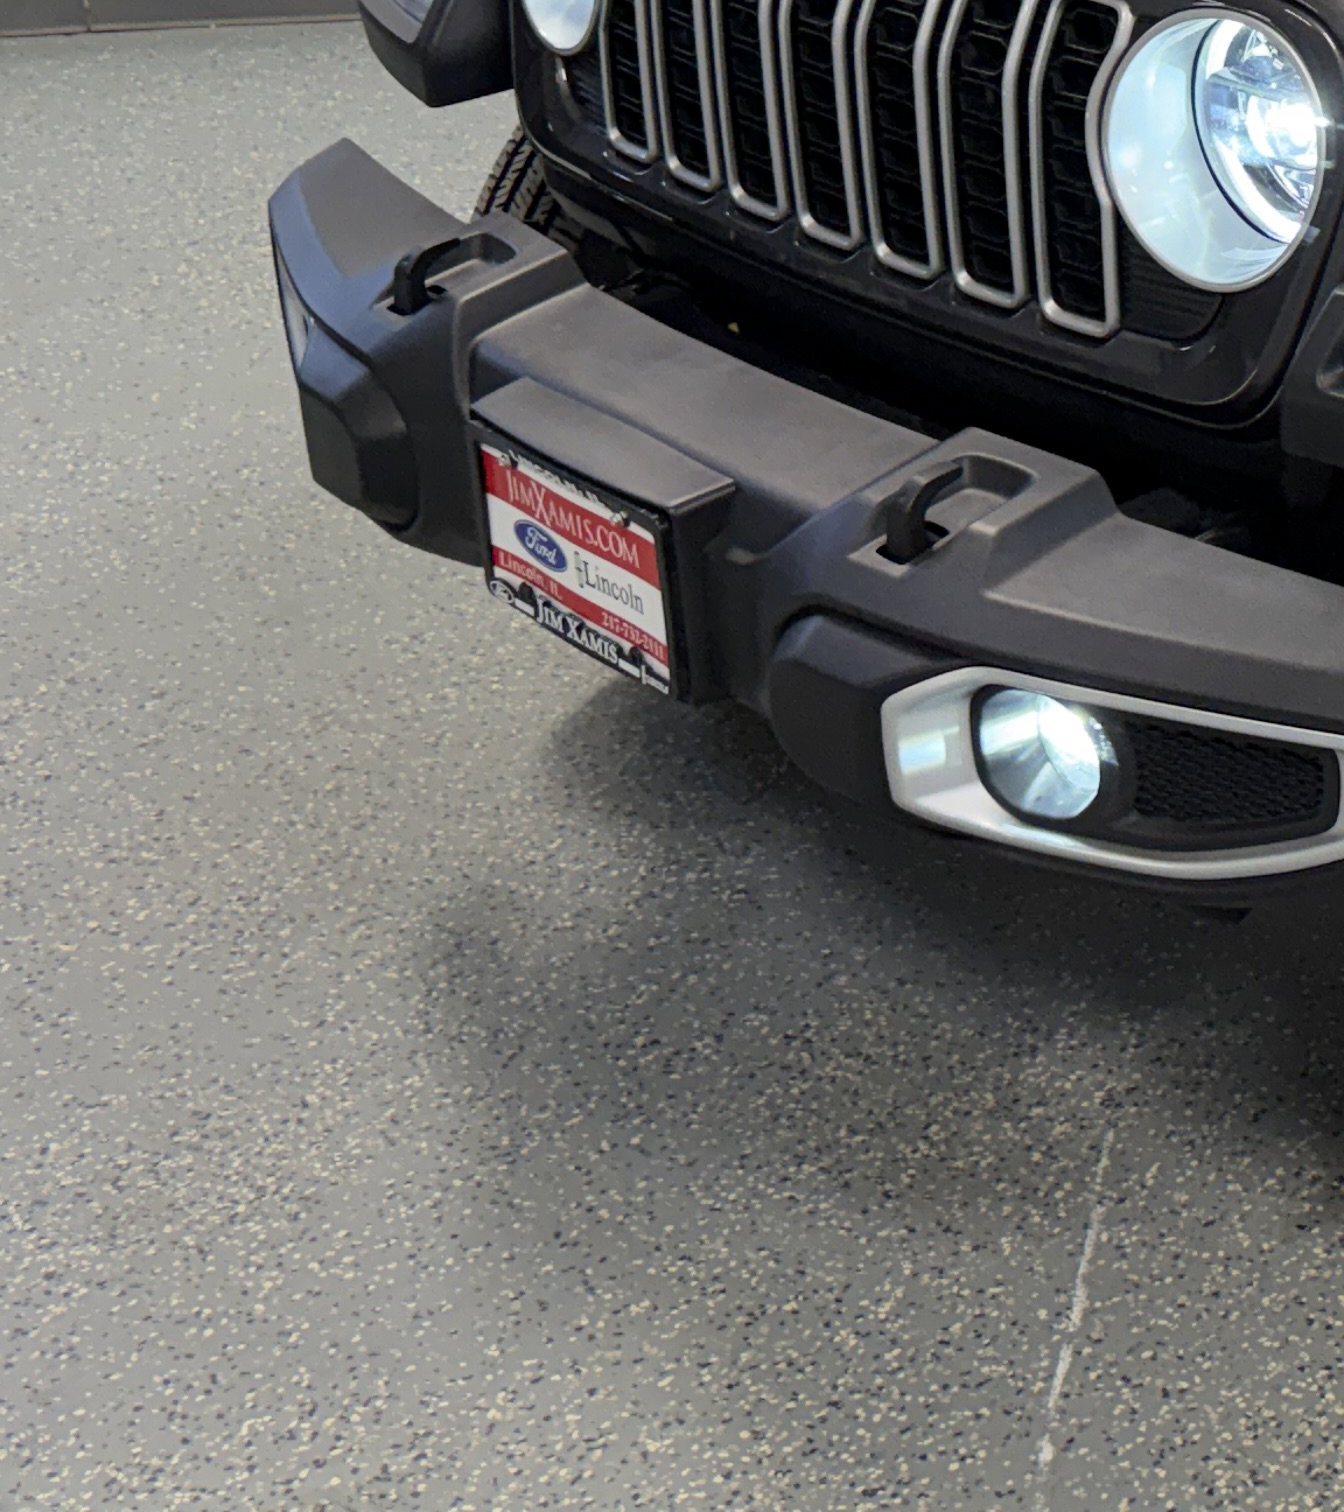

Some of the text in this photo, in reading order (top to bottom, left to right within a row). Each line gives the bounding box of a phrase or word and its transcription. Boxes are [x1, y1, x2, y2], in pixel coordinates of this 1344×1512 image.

[524, 526, 558, 566] Ford
[582, 560, 645, 616] Lincoln
[536, 597, 619, 664] JIM XAMIS
